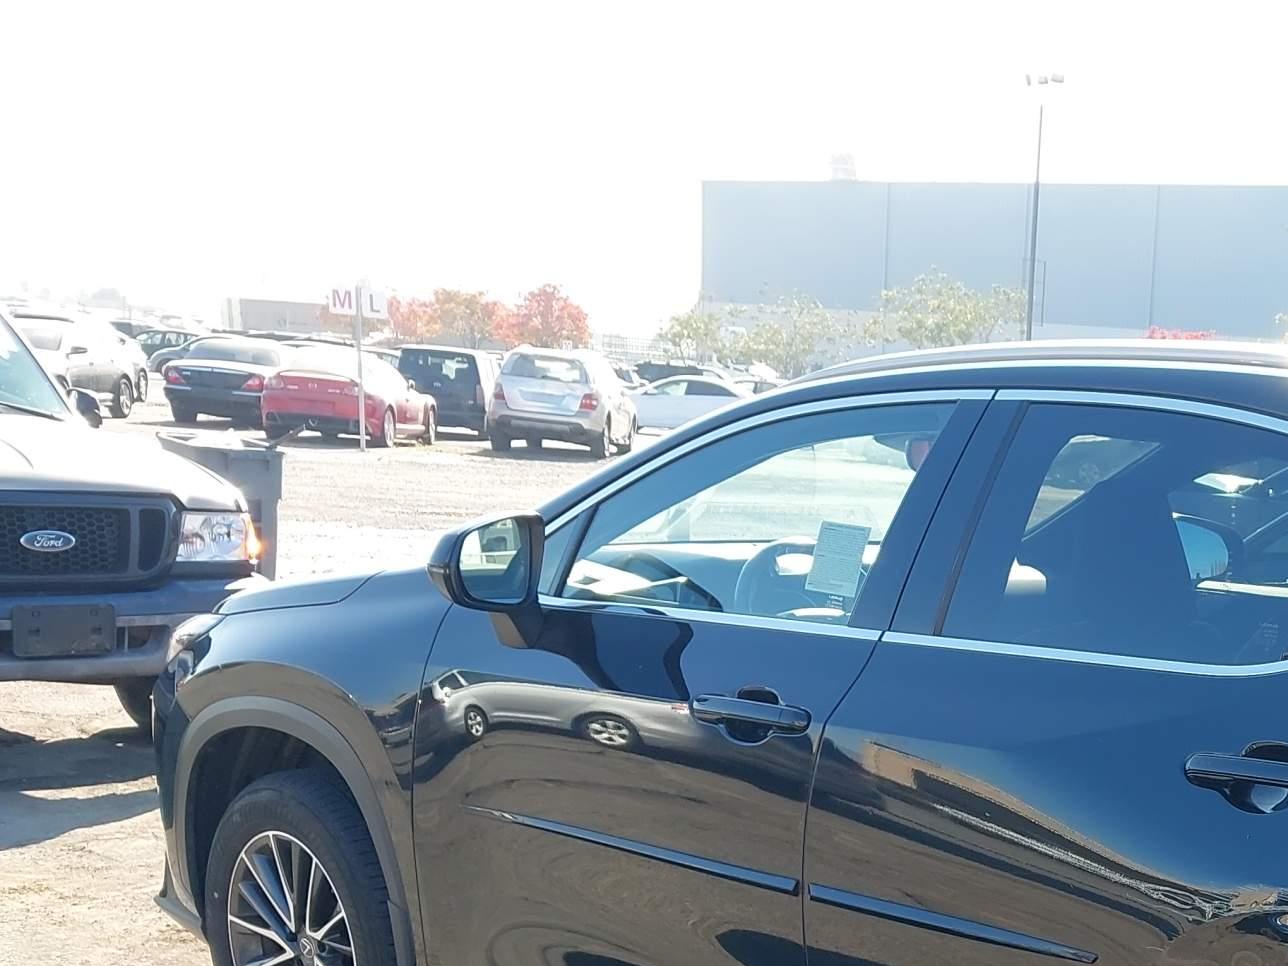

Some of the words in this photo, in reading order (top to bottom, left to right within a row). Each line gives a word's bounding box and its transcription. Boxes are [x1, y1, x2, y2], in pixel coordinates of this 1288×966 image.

[332, 288, 353, 310] M
[369, 293, 381, 313] L
[33, 534, 64, 547] Ford
